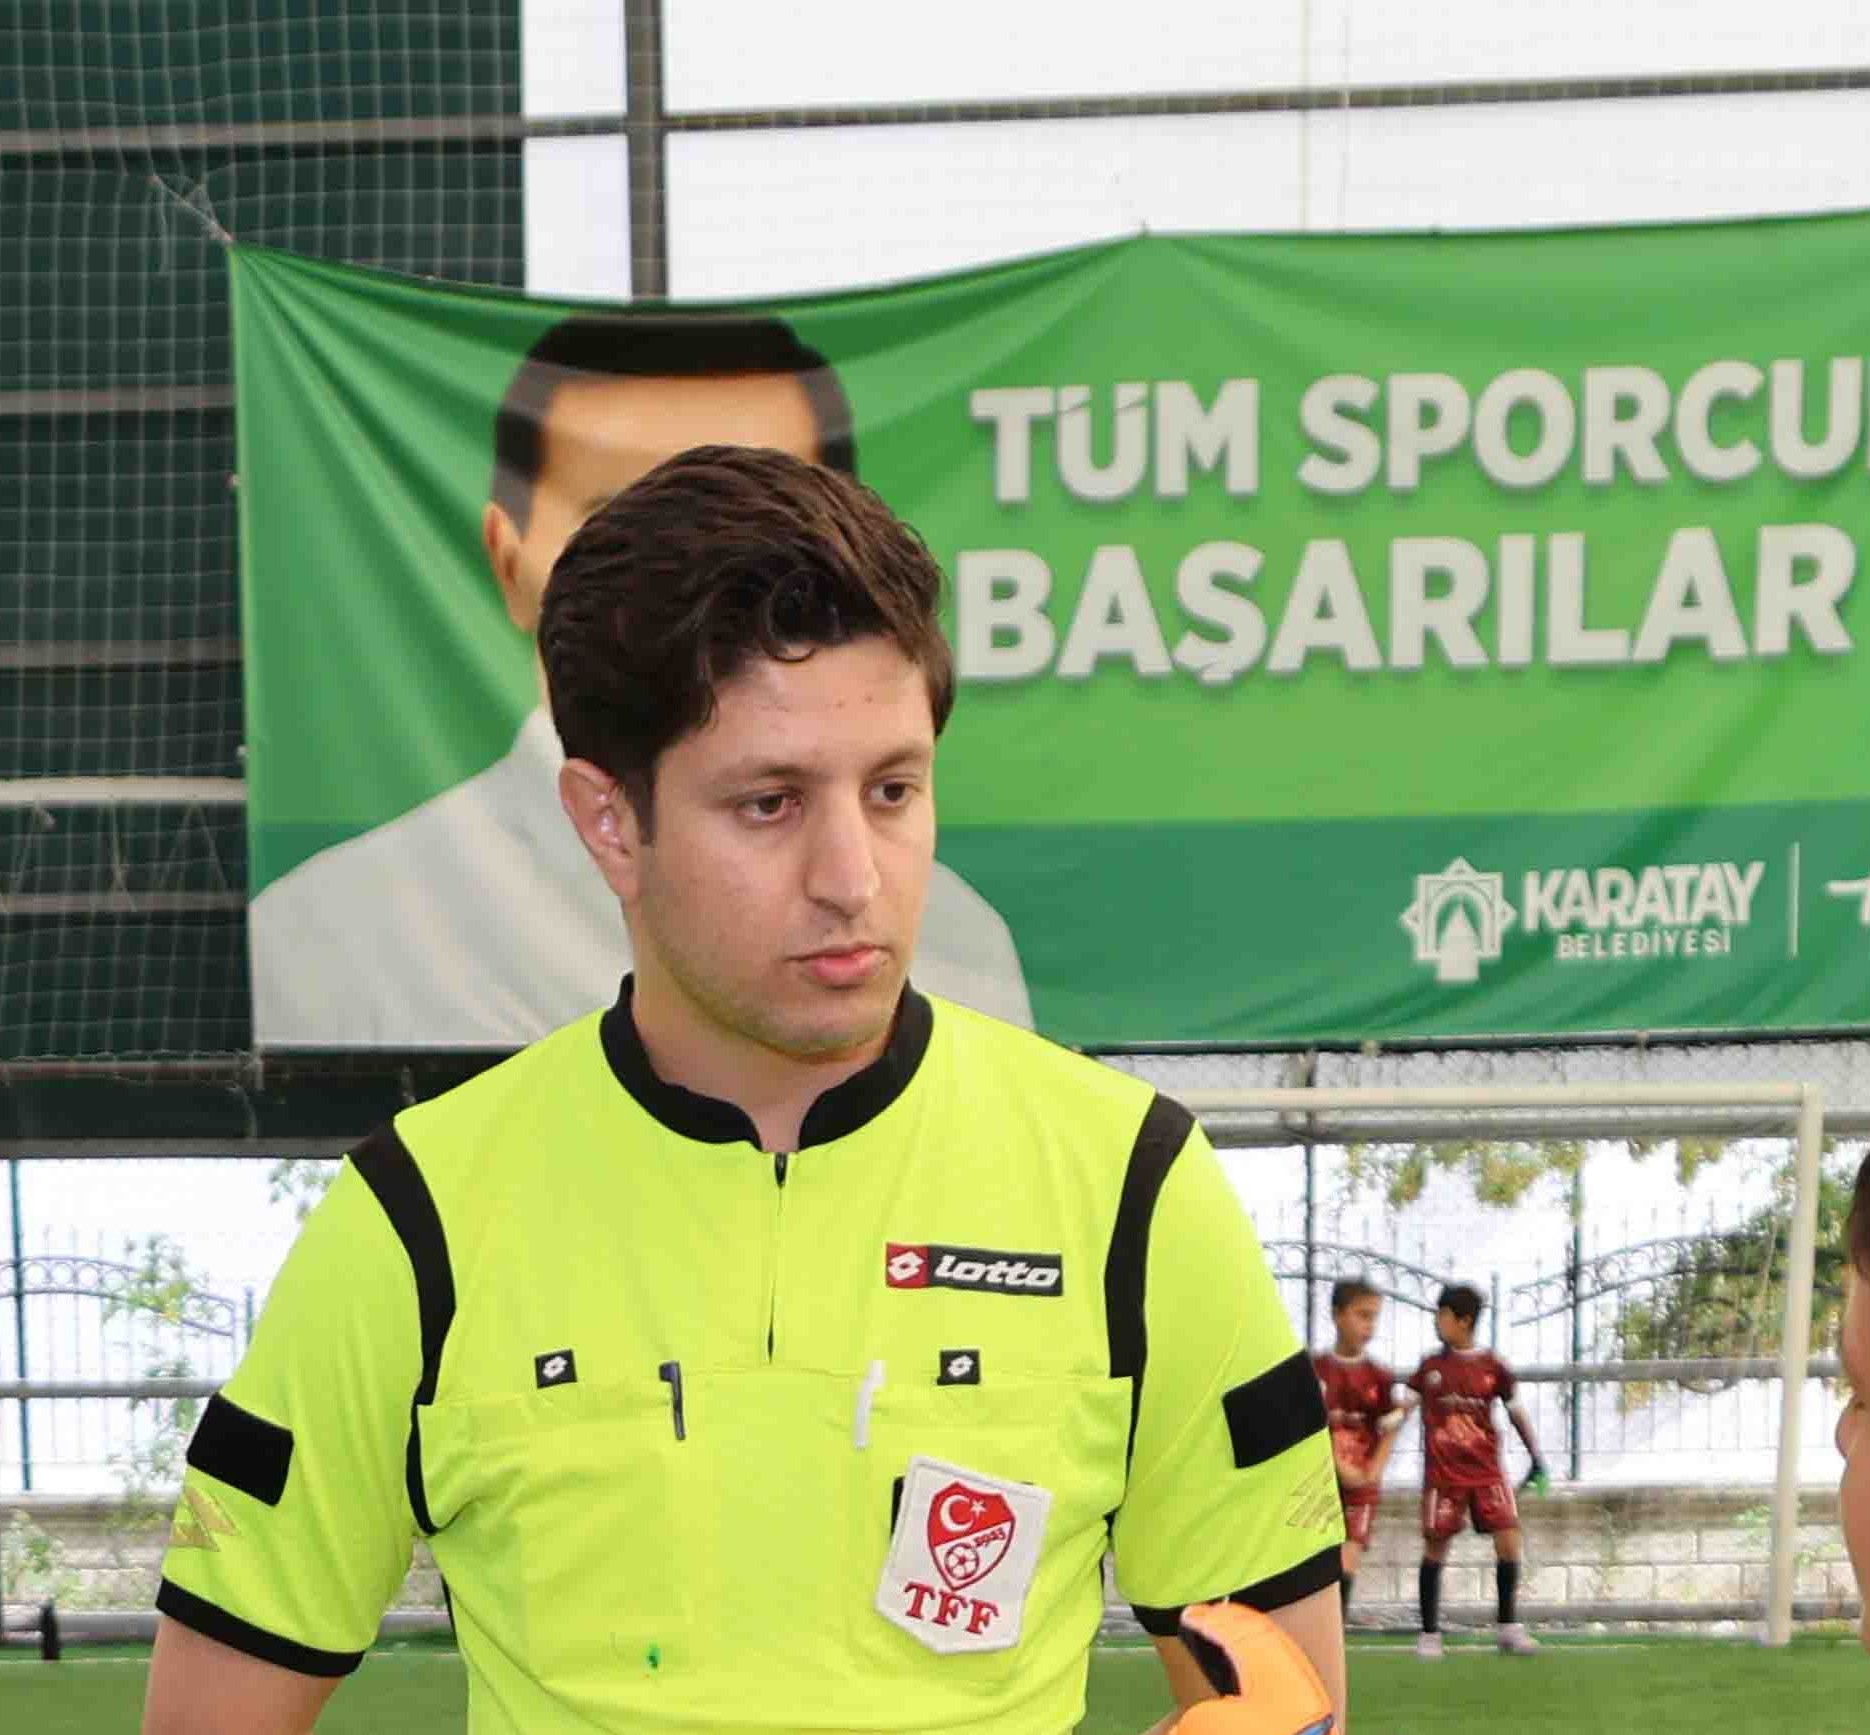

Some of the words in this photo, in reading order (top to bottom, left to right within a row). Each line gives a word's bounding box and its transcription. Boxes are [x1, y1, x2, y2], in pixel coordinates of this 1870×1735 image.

[970, 378, 1259, 503] TÜM
[956, 522, 1857, 683] BAŞARILAR
[1523, 861, 1765, 933] KARATAY
[1557, 927, 1731, 961] BELEDİYESİ
[903, 1581, 999, 1635] TFF
